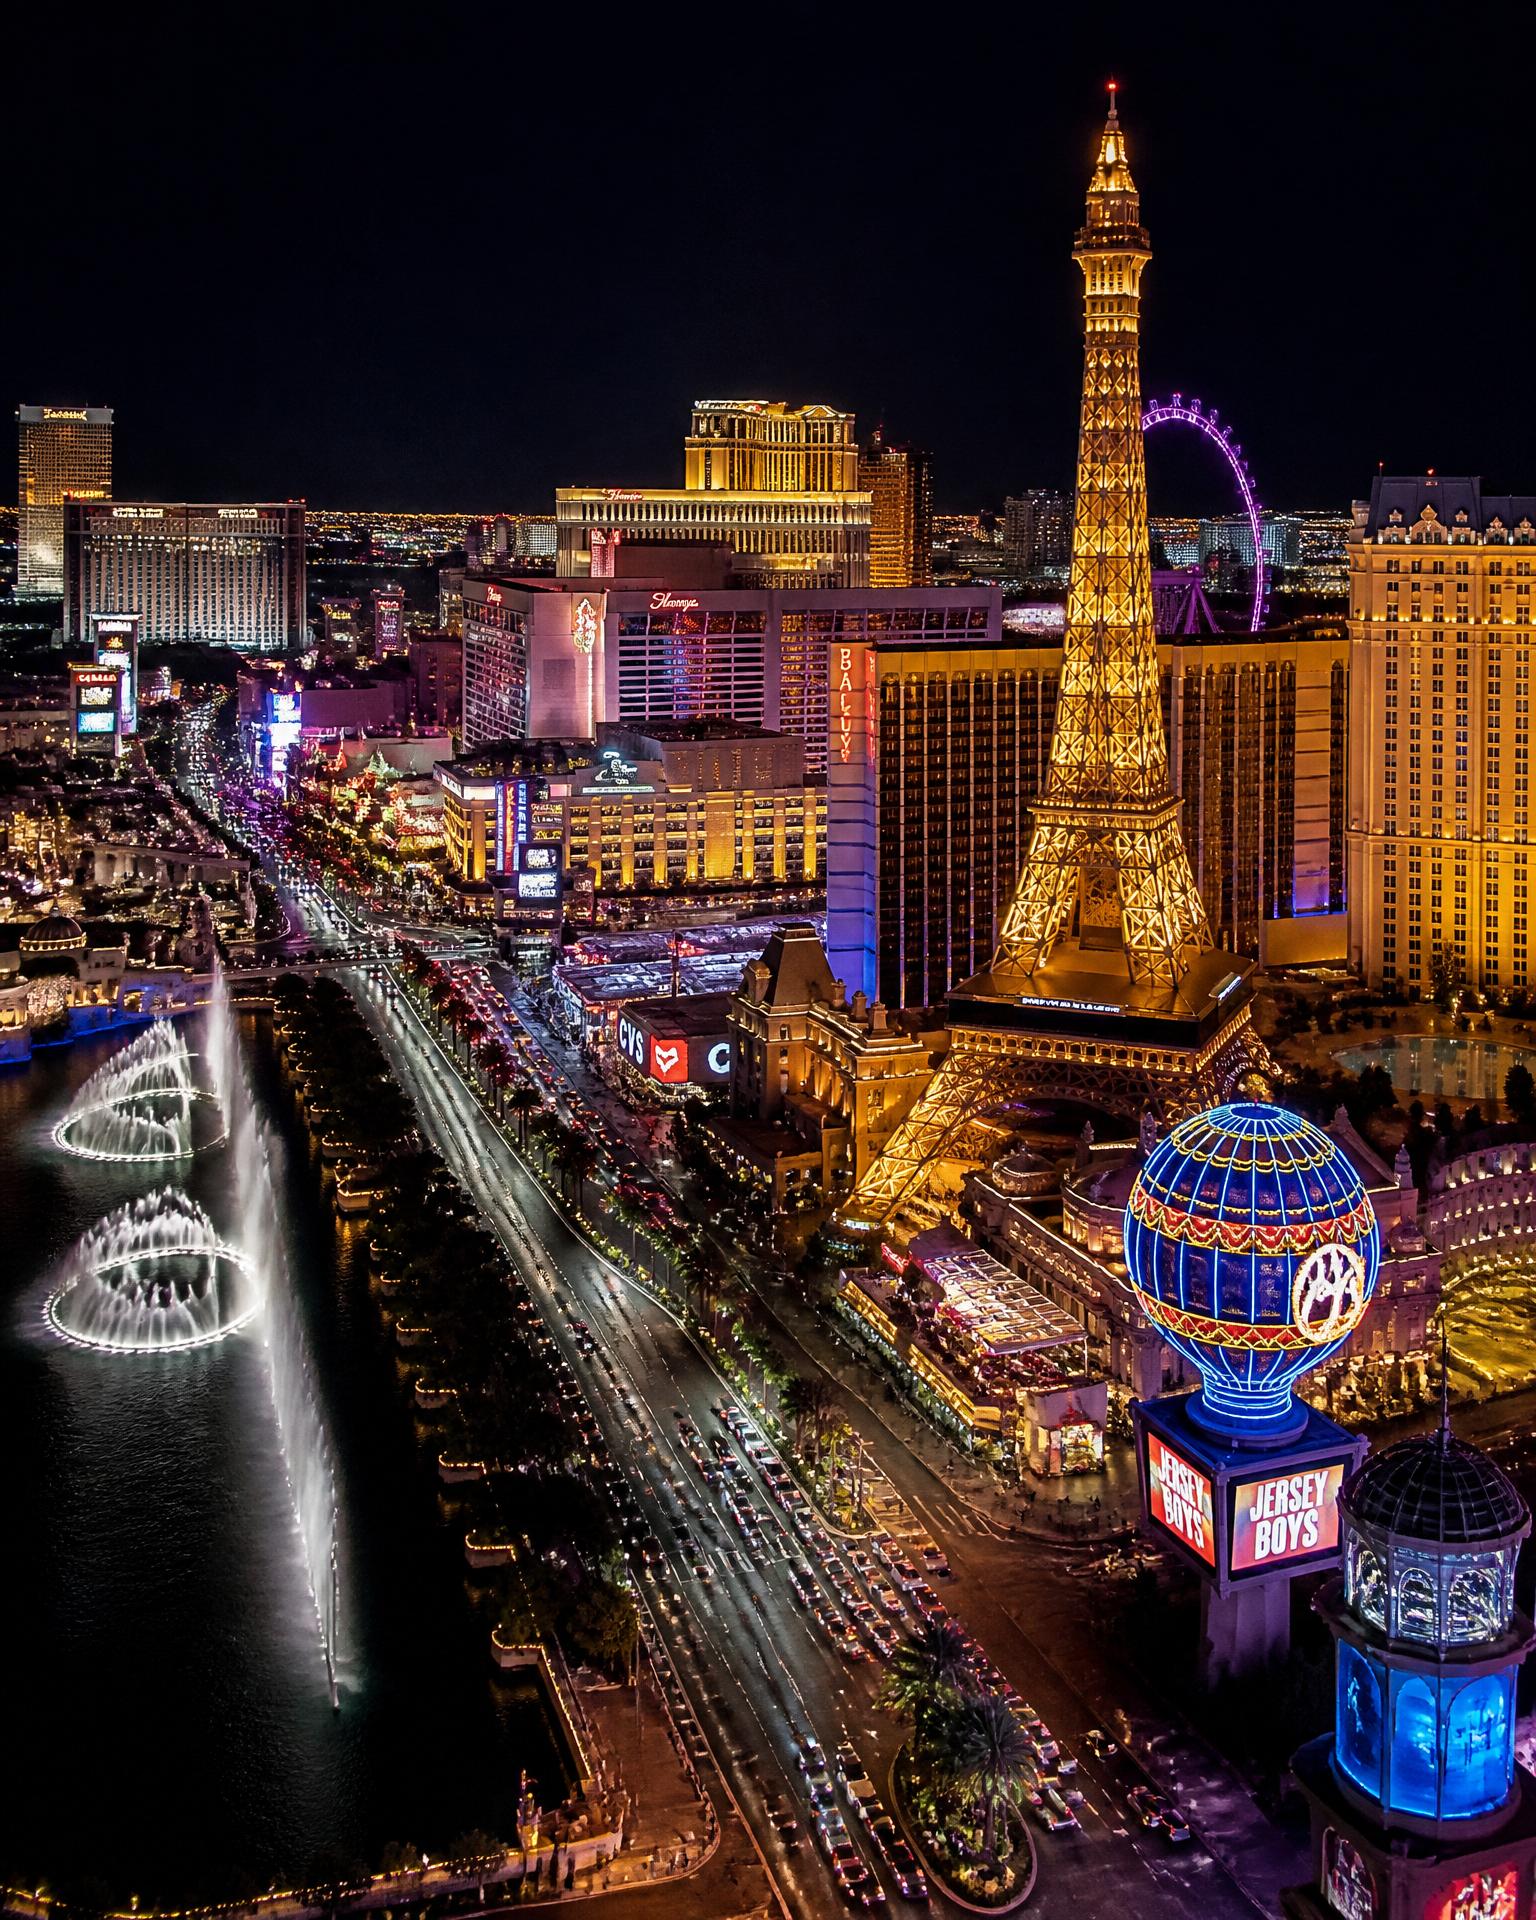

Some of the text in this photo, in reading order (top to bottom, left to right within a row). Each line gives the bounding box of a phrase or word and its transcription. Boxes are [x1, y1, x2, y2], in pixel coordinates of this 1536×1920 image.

[619, 1018, 644, 1065] CVS
[1157, 1446, 1205, 1513] JERSEY
[1250, 1470, 1329, 1522] JERSEY
[1160, 1482, 1205, 1549] BOYS
[1254, 1508, 1319, 1560] BOYS
